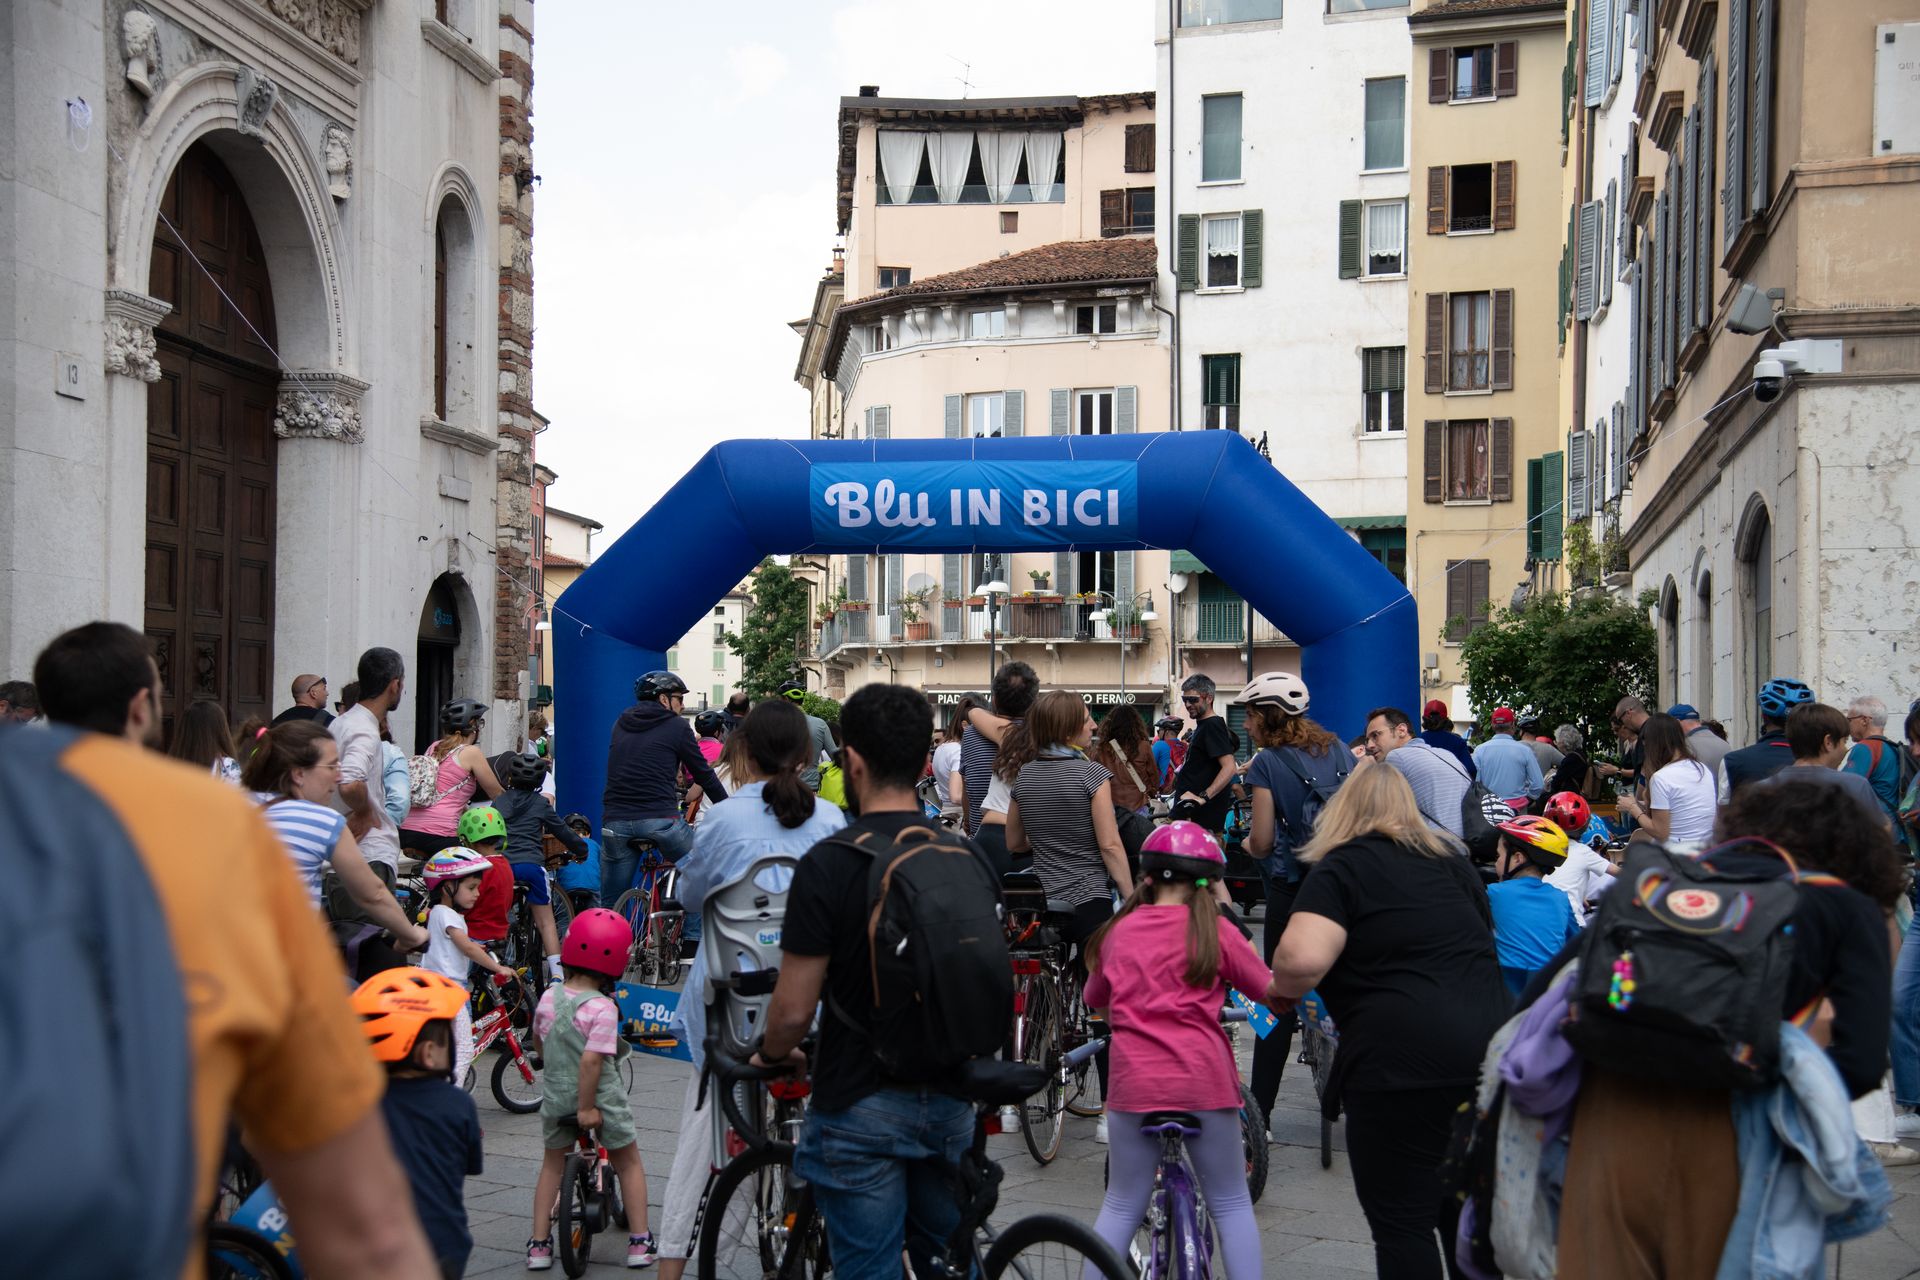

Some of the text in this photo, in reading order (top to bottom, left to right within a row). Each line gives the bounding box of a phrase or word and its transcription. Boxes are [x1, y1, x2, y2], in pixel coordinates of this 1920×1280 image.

[824, 478, 1119, 528] Blu IN BICI
[640, 1002, 675, 1023] Blu
